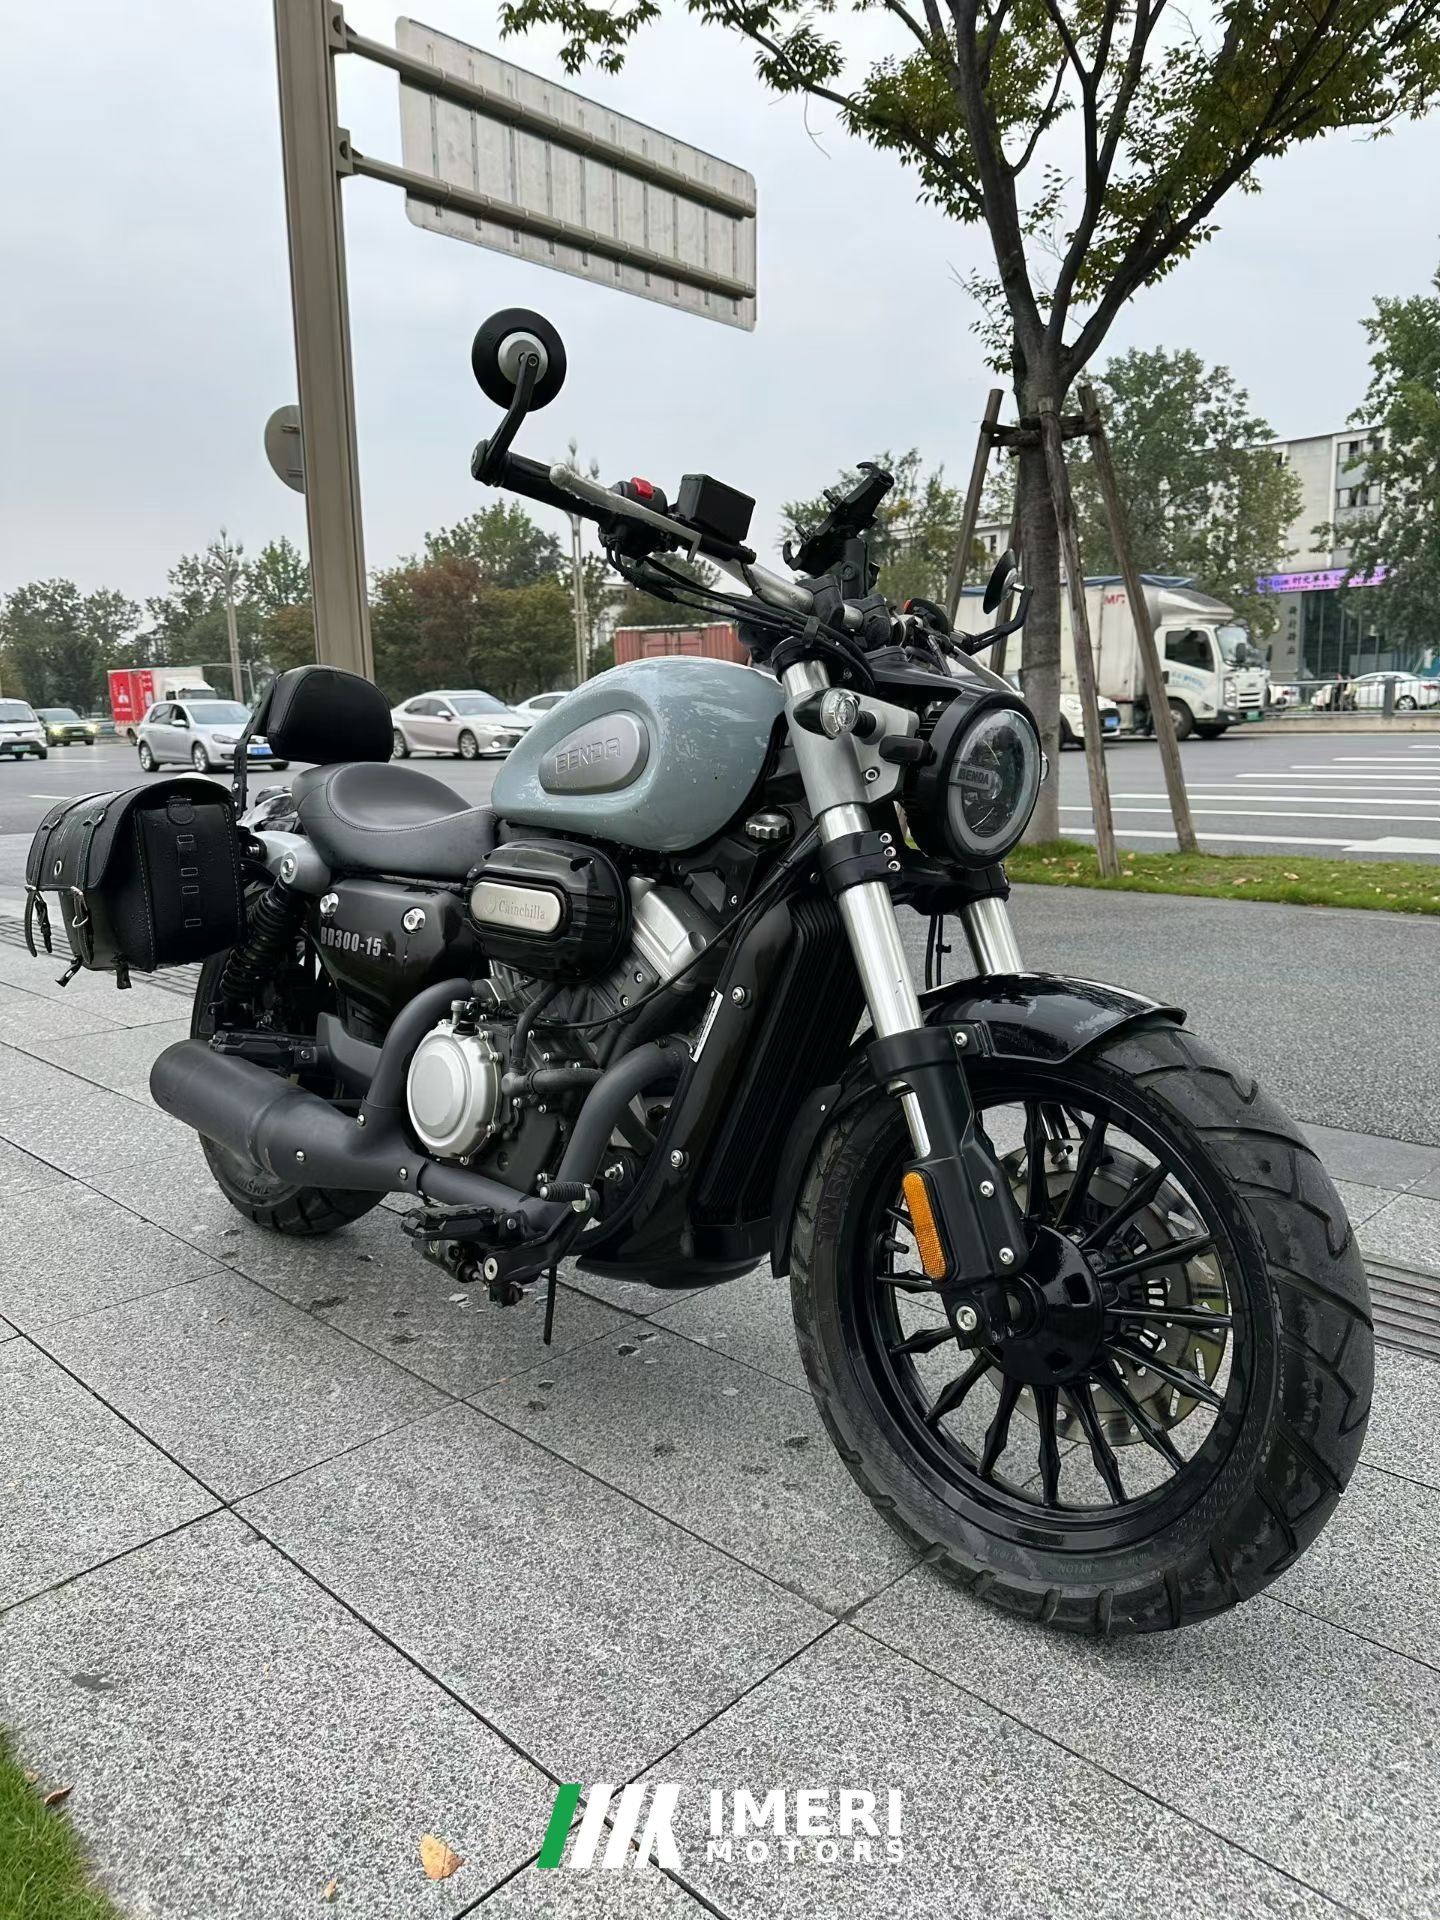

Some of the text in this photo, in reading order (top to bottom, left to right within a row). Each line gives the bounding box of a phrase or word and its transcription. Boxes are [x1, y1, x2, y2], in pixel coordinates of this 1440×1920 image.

[555, 737, 621, 775] BENDA
[957, 767, 989, 785] BENDA
[320, 926, 382, 957] BD300-15
